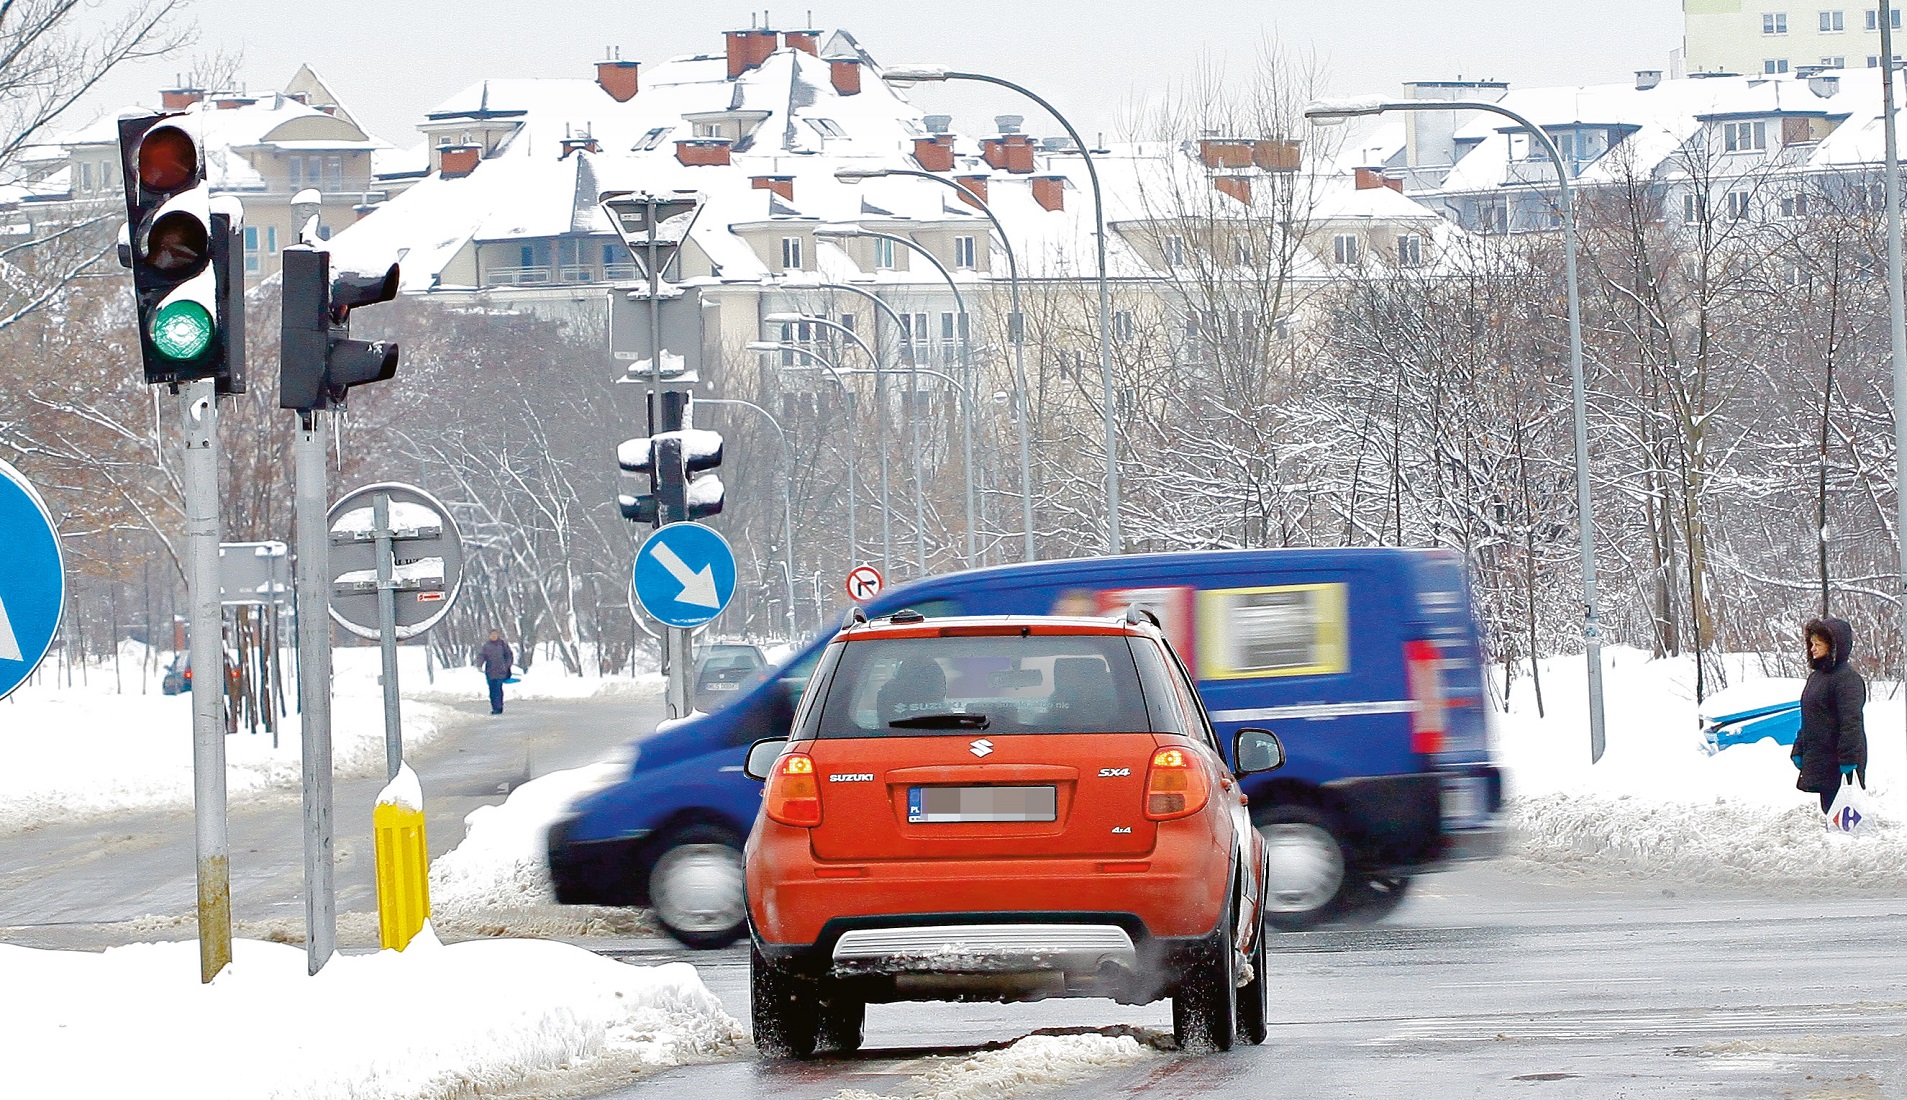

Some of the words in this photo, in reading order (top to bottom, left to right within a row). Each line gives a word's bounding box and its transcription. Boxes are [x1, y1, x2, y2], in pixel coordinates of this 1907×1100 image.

[1097, 767, 1131, 777] SX4
[829, 773, 874, 782] SUZUKI
[910, 806, 920, 814] PL
[1111, 826, 1132, 834] 4x4
